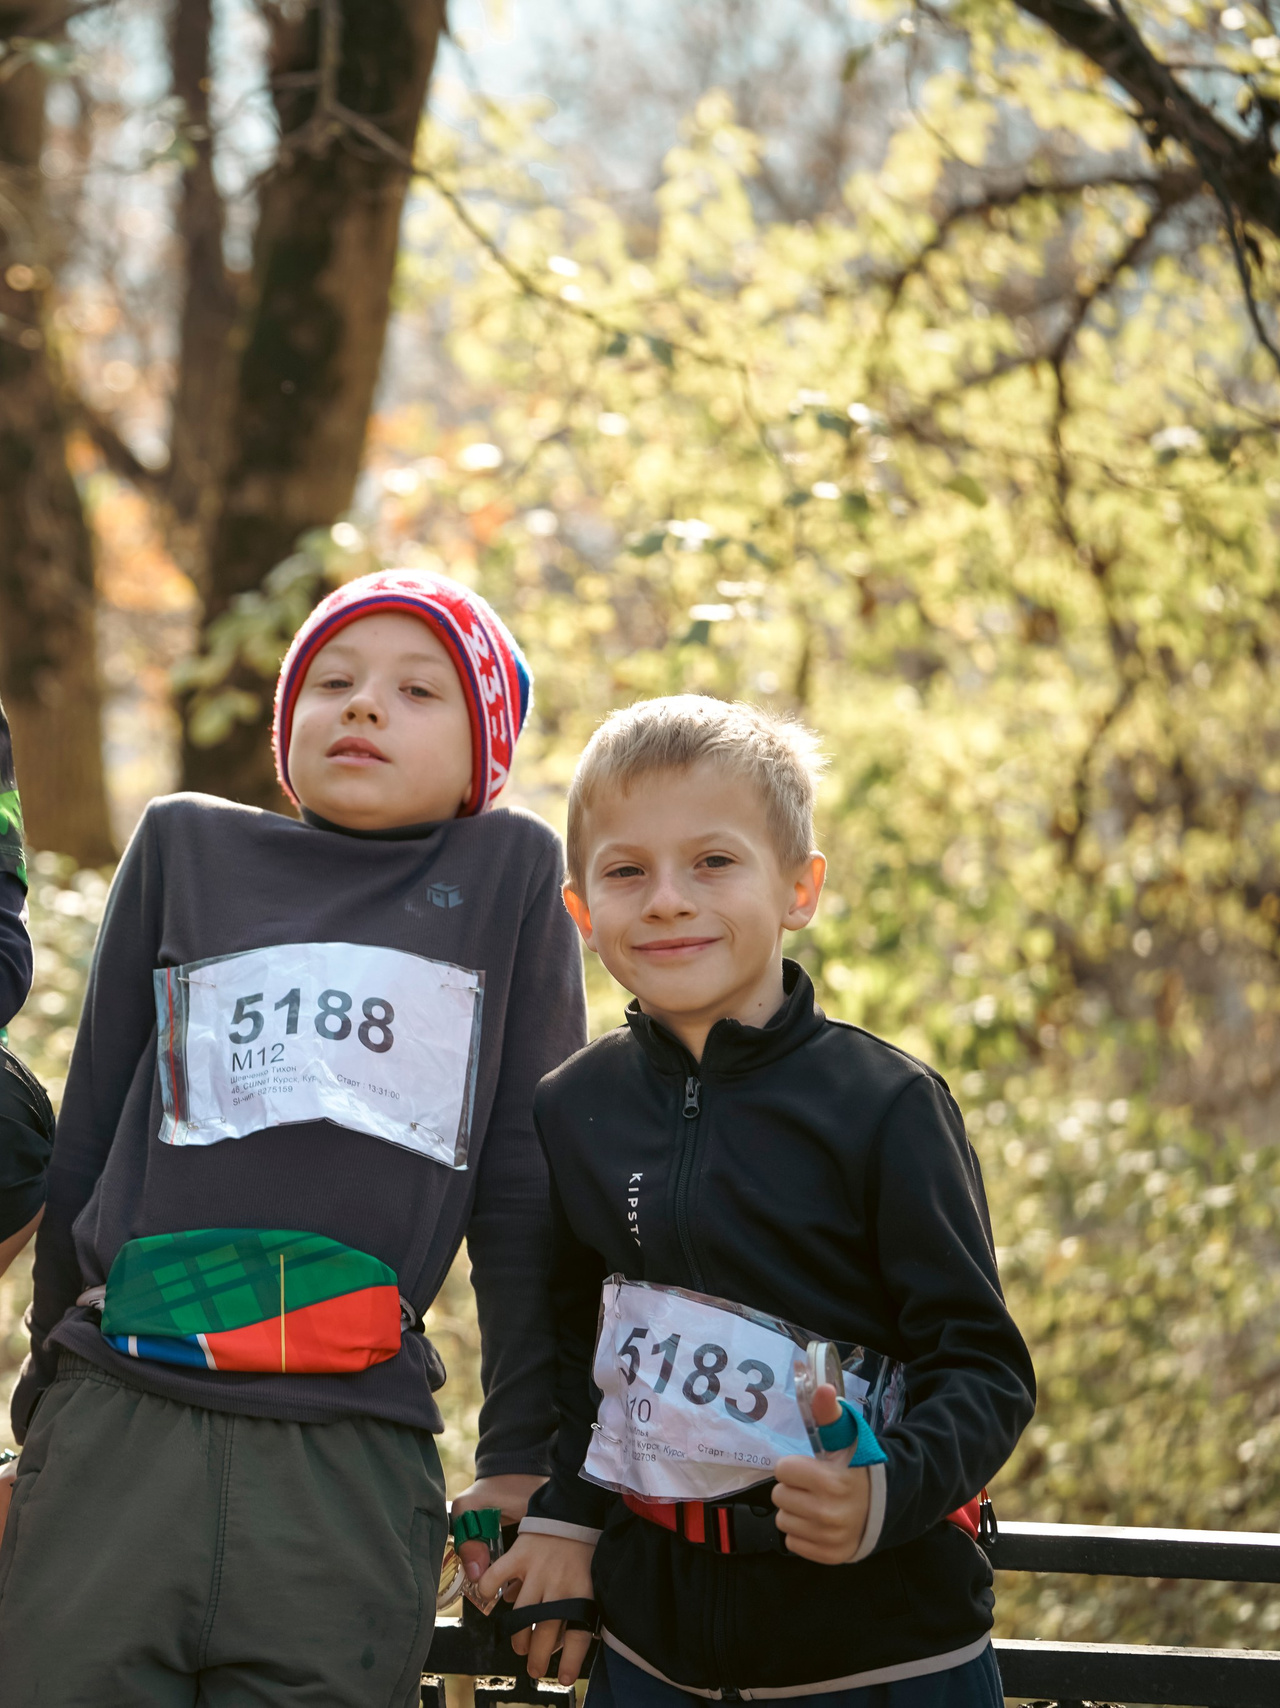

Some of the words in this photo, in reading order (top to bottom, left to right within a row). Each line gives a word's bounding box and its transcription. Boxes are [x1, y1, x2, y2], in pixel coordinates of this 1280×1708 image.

[228, 988, 395, 1054] 5188
[271, 1065, 297, 1074] Тихон
[336, 1073, 361, 1089] Старт
[617, 1327, 776, 1424] 5183
[663, 1445, 687, 1459] Курск
[697, 1443, 725, 1458] Старт
[733, 1451, 771, 1466] 13:20:00
